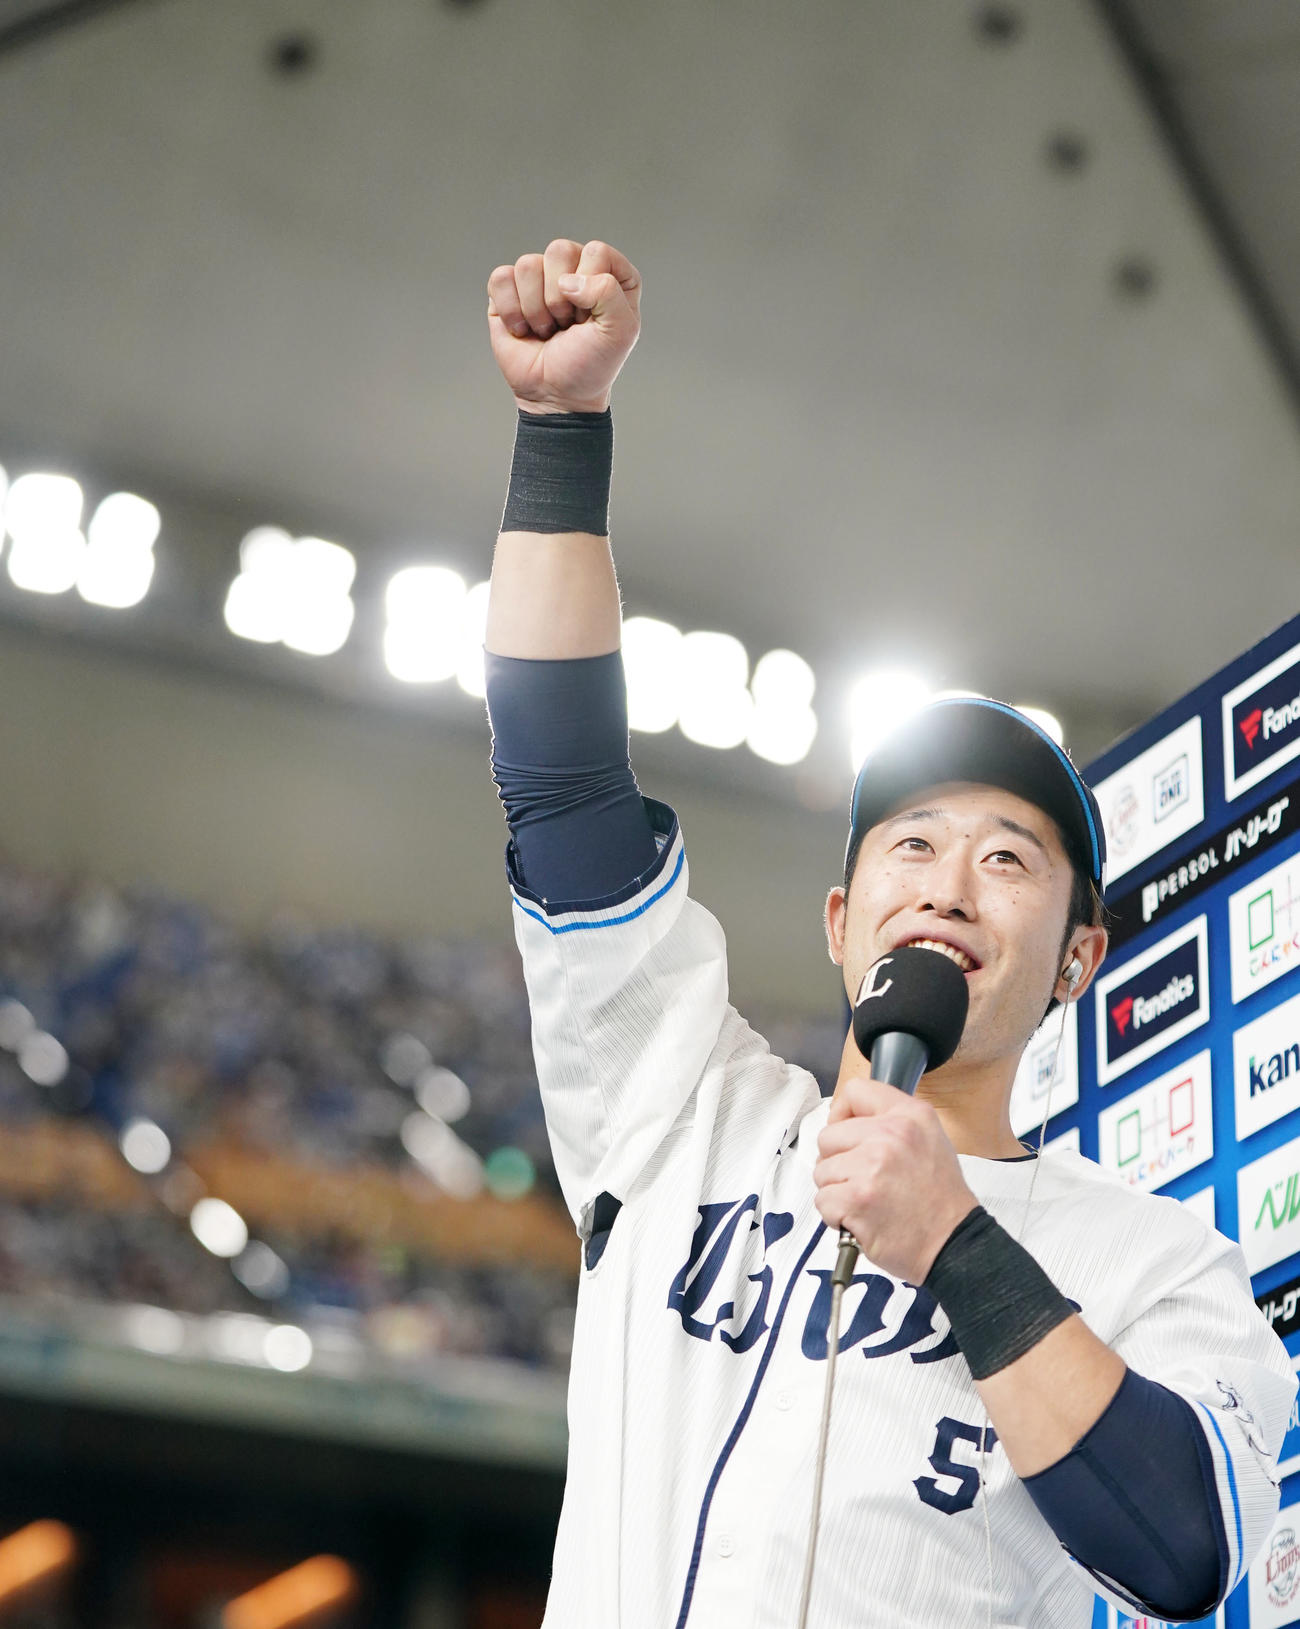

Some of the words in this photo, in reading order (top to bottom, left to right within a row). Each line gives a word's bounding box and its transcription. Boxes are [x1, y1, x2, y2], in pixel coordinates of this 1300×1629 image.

[1262, 694, 1300, 740] Fana
[1159, 847, 1219, 902] PERSOL
[855, 957, 894, 1008] L
[1132, 973, 1195, 1030] Fanatics
